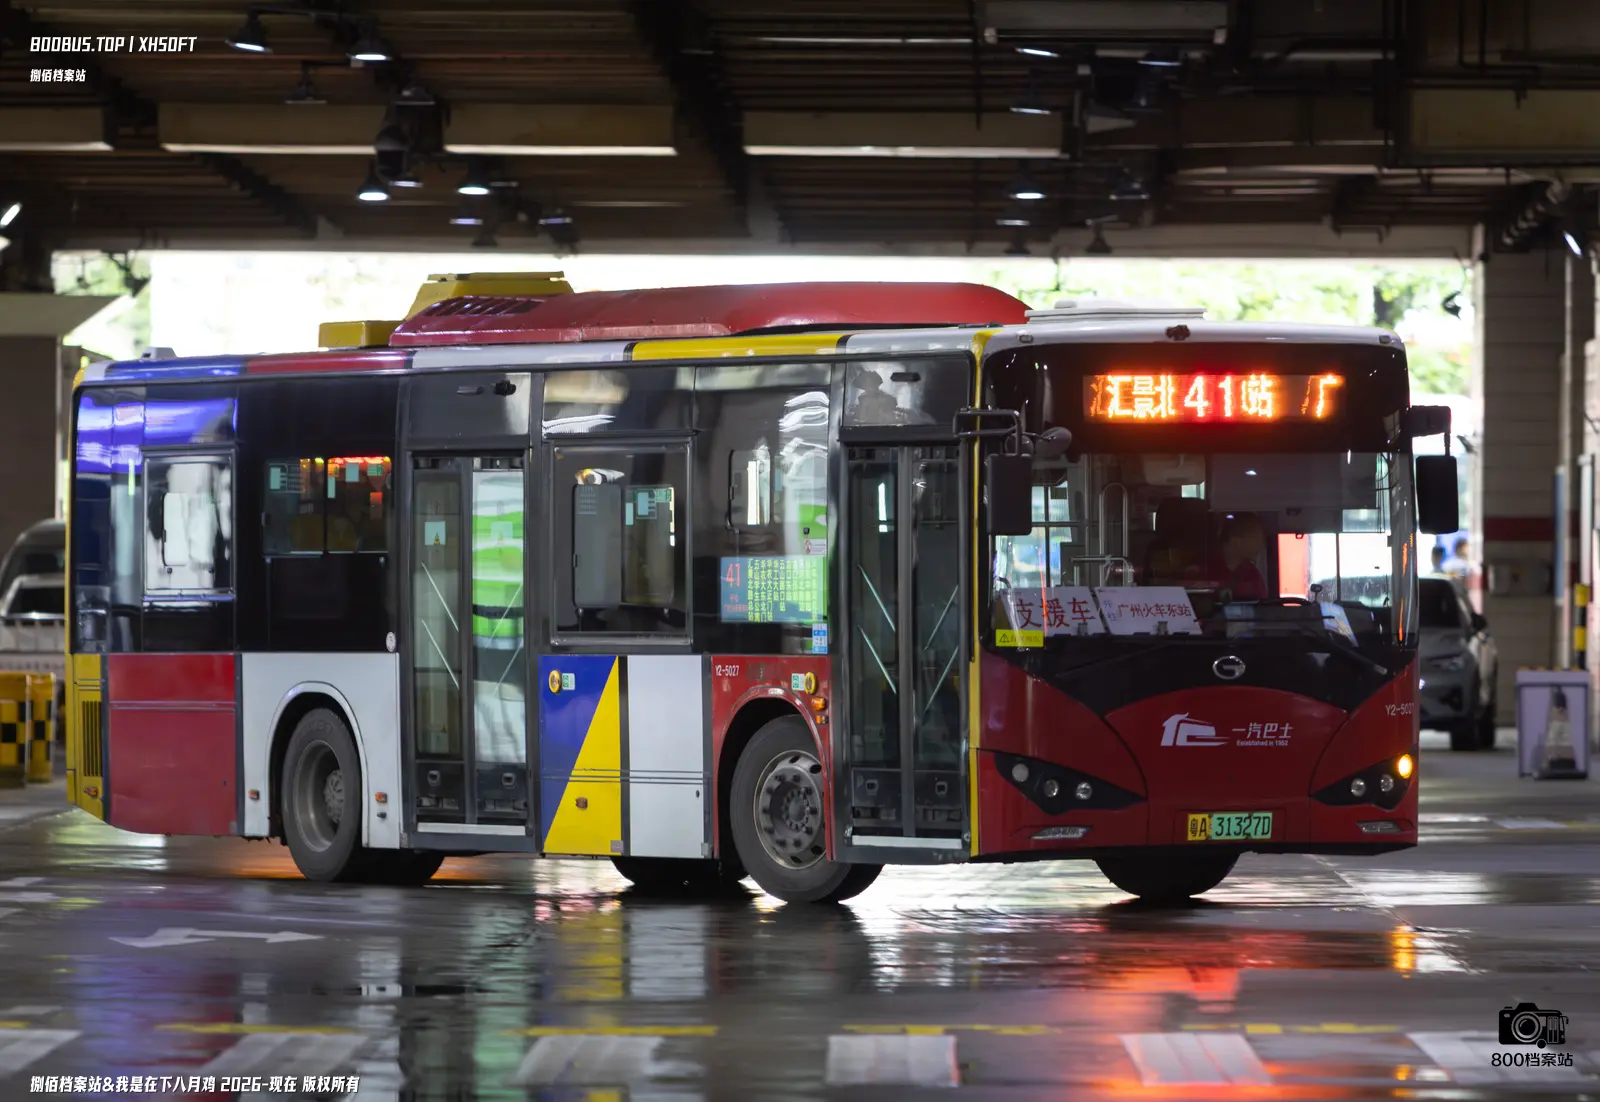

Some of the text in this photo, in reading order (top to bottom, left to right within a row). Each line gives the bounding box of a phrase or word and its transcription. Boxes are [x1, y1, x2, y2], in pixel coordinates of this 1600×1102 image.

[725, 563, 741, 589] 41
[1015, 597, 1095, 629] 支援车
[1117, 603, 1192, 617] 广州火车东站
[715, 664, 740, 677] Y2-5027
[1231, 722, 1294, 739] 一汽巴士
